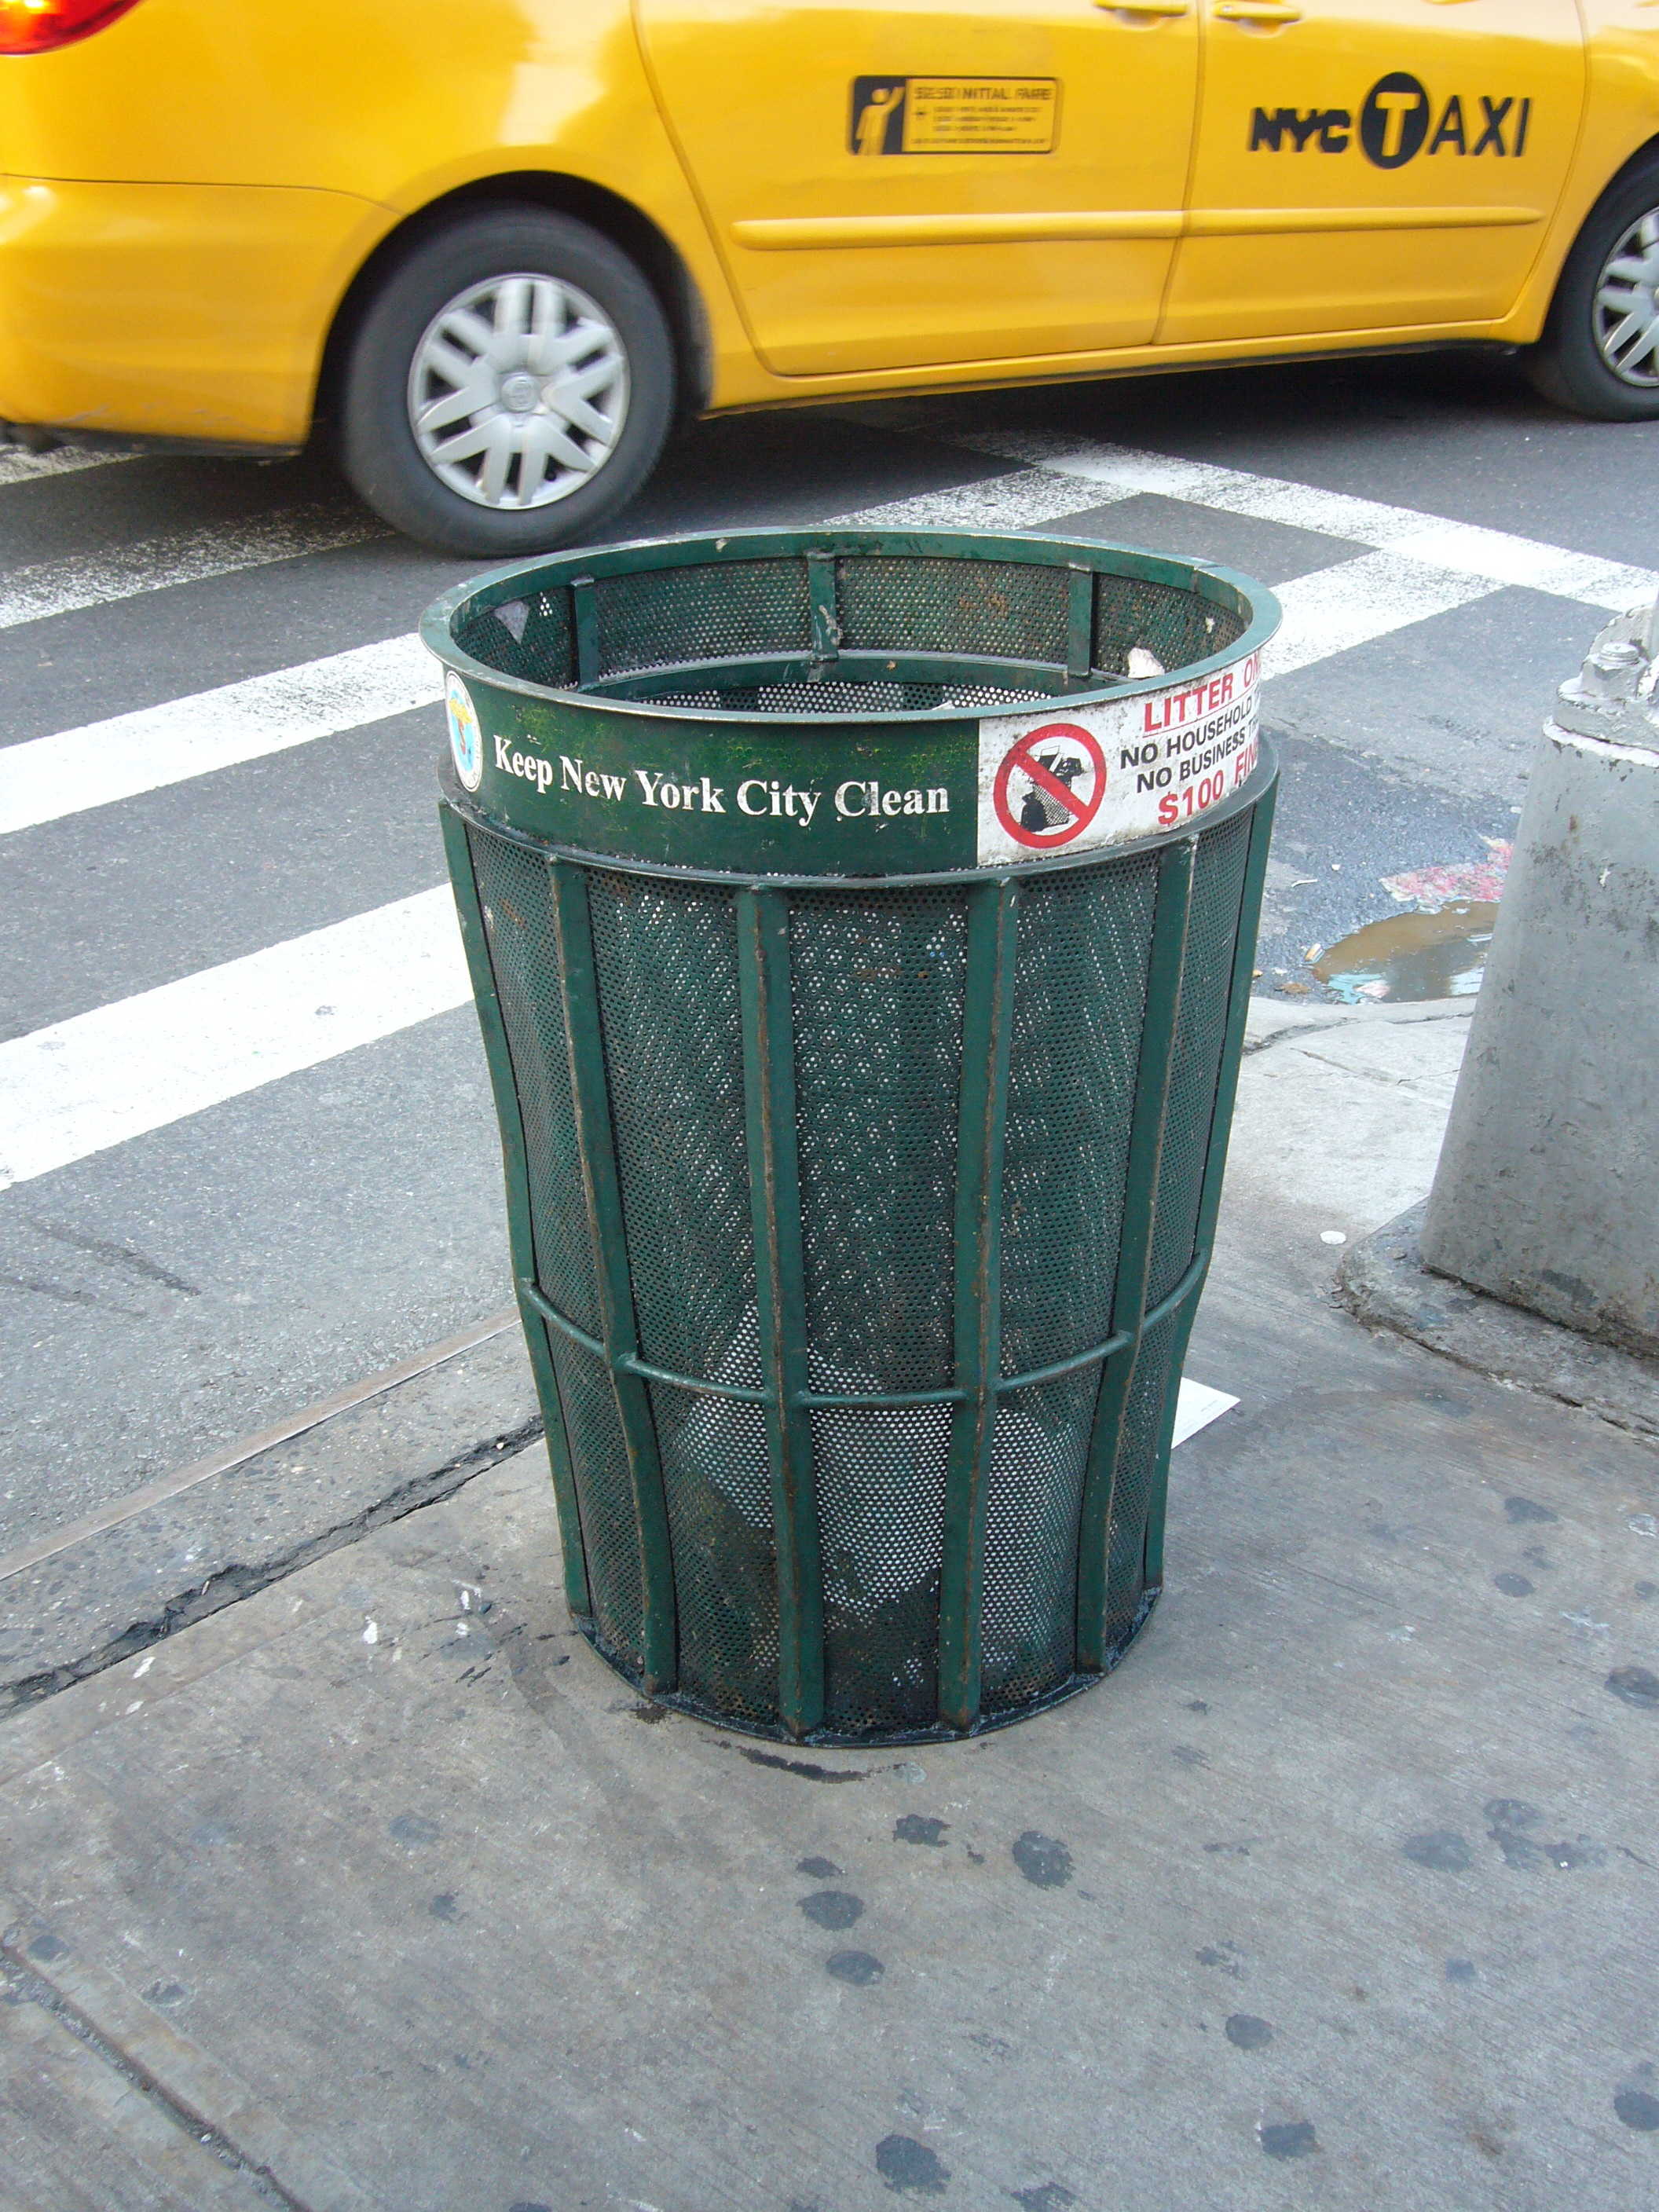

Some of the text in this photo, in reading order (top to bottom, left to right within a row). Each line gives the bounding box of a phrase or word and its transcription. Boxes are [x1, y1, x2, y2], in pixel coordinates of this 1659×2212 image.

[1249, 107, 1352, 154] NYC
[1119, 742, 1159, 770] NO
[1166, 694, 1252, 759] HOUSEHOLD
[1144, 672, 1234, 732] LITTER
[493, 734, 950, 827] Keep New York City Clean
[1137, 770, 1173, 793] NO
[1179, 726, 1246, 781] BUSINESS
[1158, 768, 1225, 827] $100
